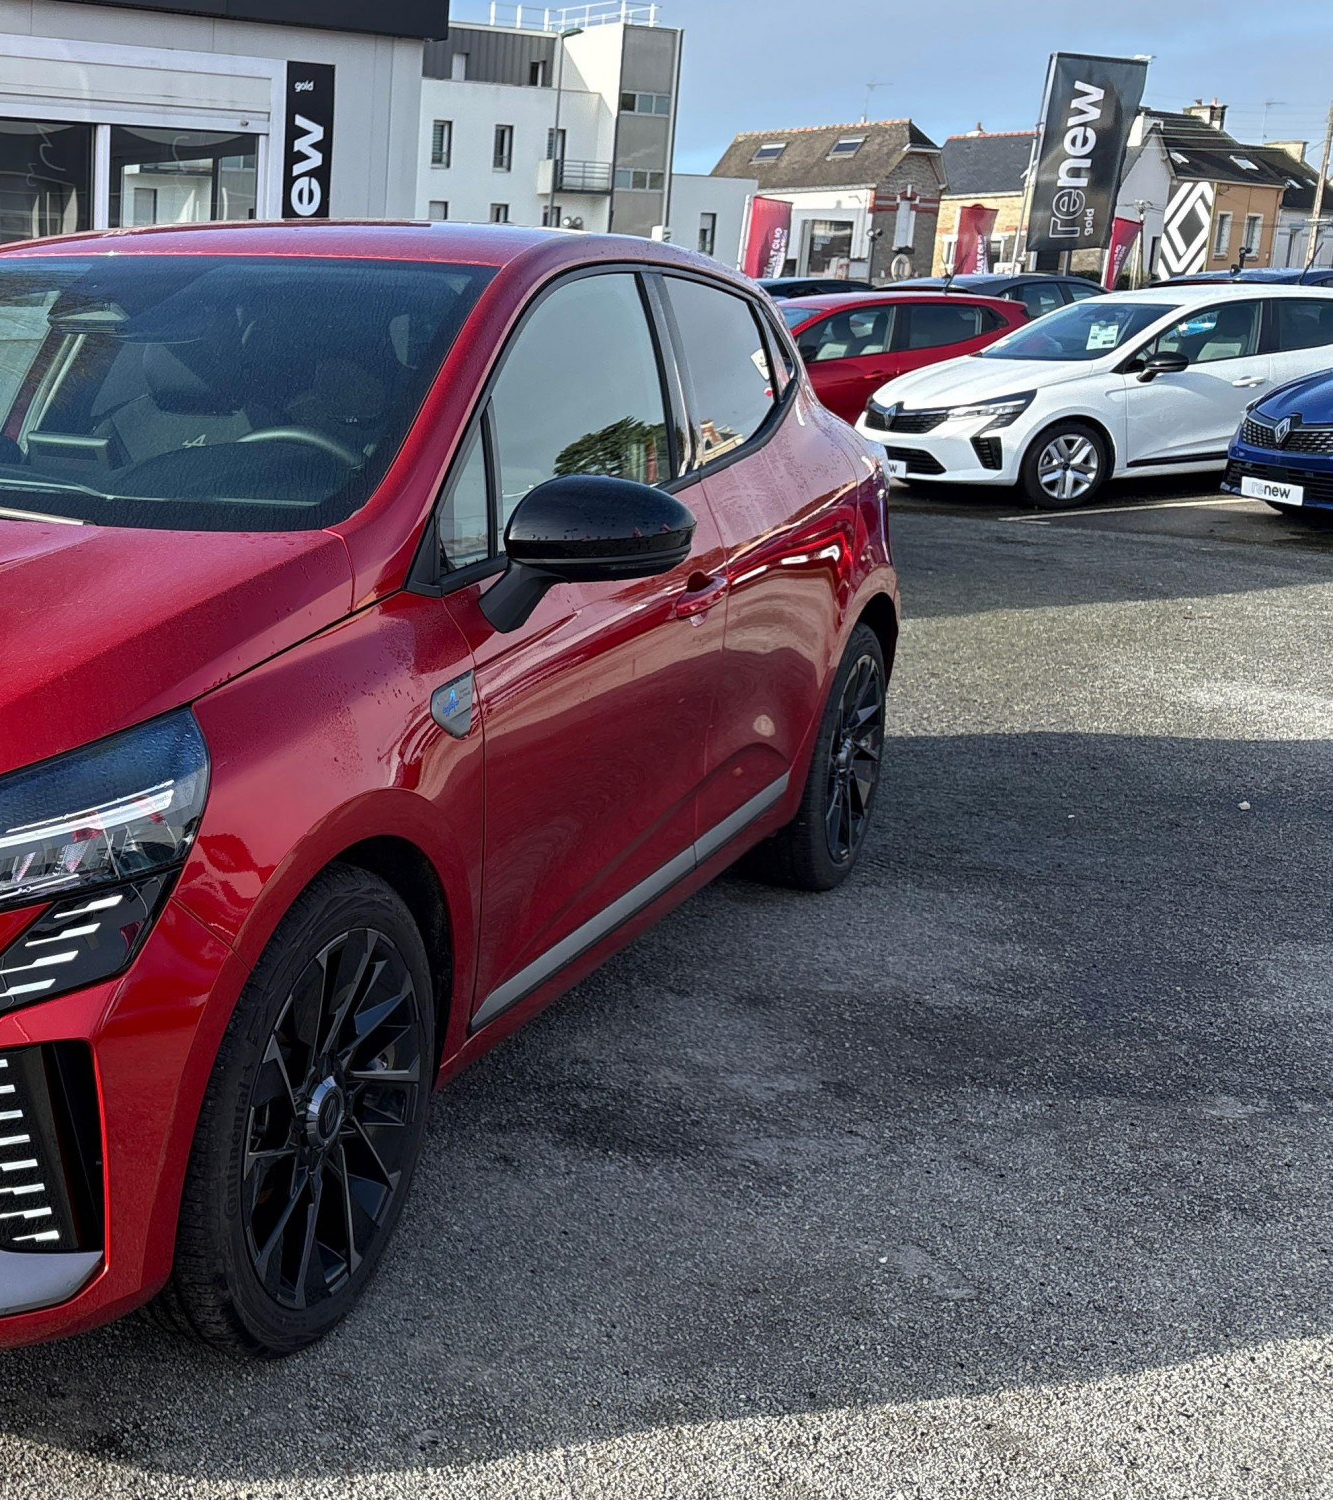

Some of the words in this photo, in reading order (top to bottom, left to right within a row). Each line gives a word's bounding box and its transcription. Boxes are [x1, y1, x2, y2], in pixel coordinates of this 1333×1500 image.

[295, 81, 314, 92] gold
[1049, 80, 1105, 238] renew
[1083, 208, 1095, 236] gold
[1251, 481, 1291, 499] renew
